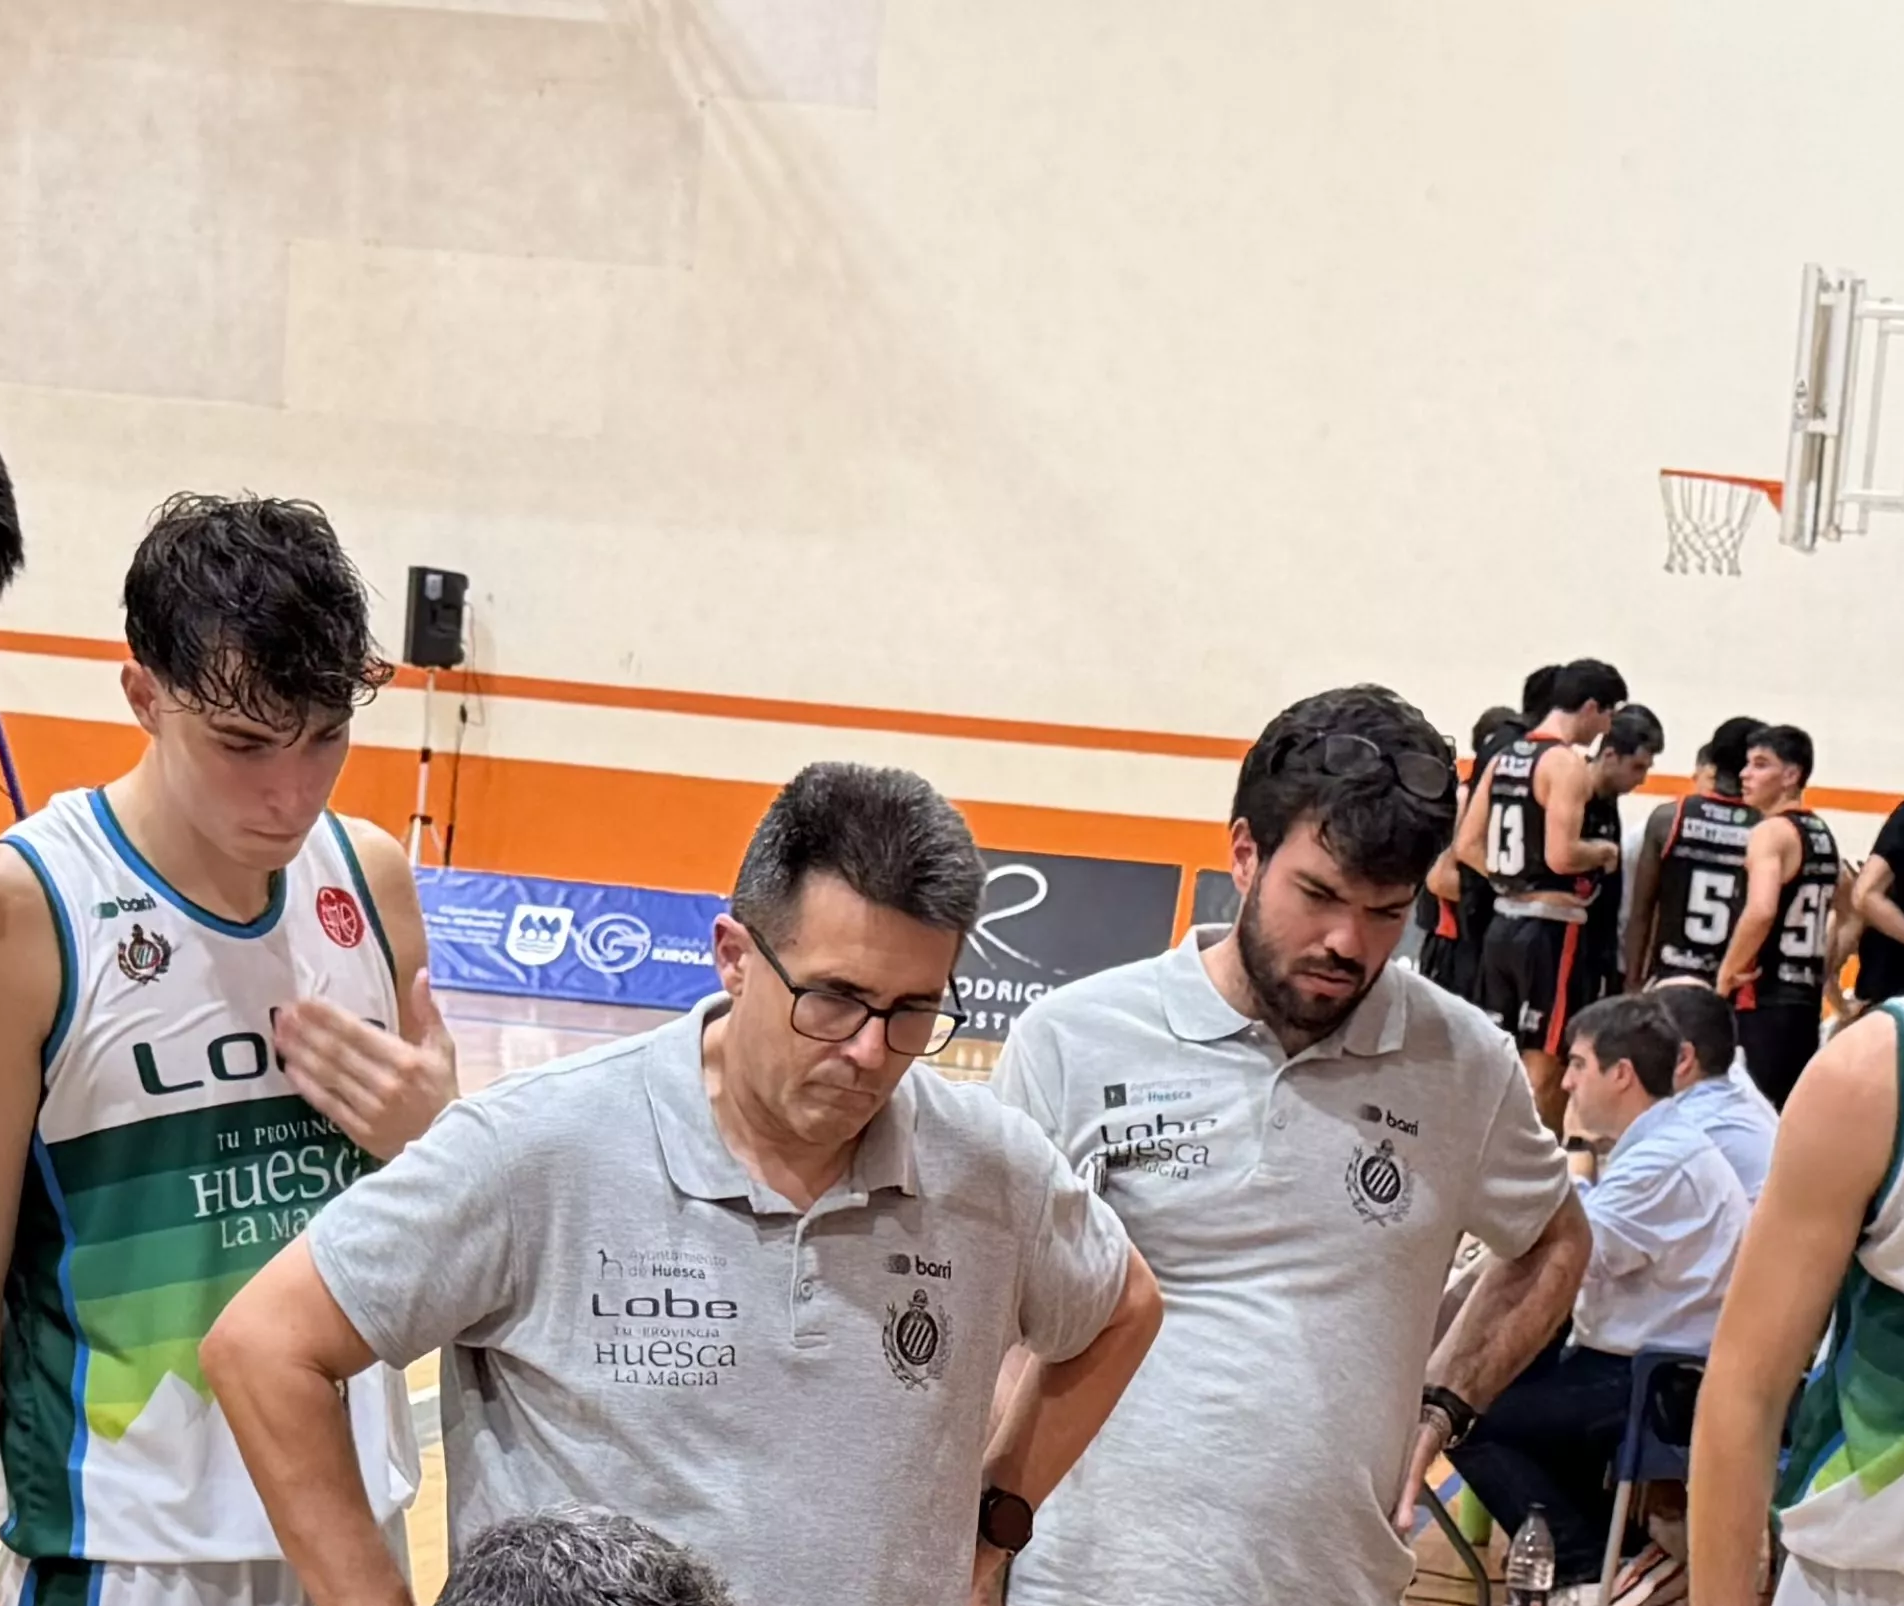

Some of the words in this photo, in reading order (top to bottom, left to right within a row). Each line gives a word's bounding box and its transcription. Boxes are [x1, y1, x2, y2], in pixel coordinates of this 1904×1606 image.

[1486, 803, 1527, 877] 13
[1684, 869, 1736, 945] 5
[652, 1264, 706, 1280] Huesca
[915, 1254, 952, 1280] barri
[592, 1288, 738, 1319] Lobe
[595, 1340, 737, 1368] Huesca
